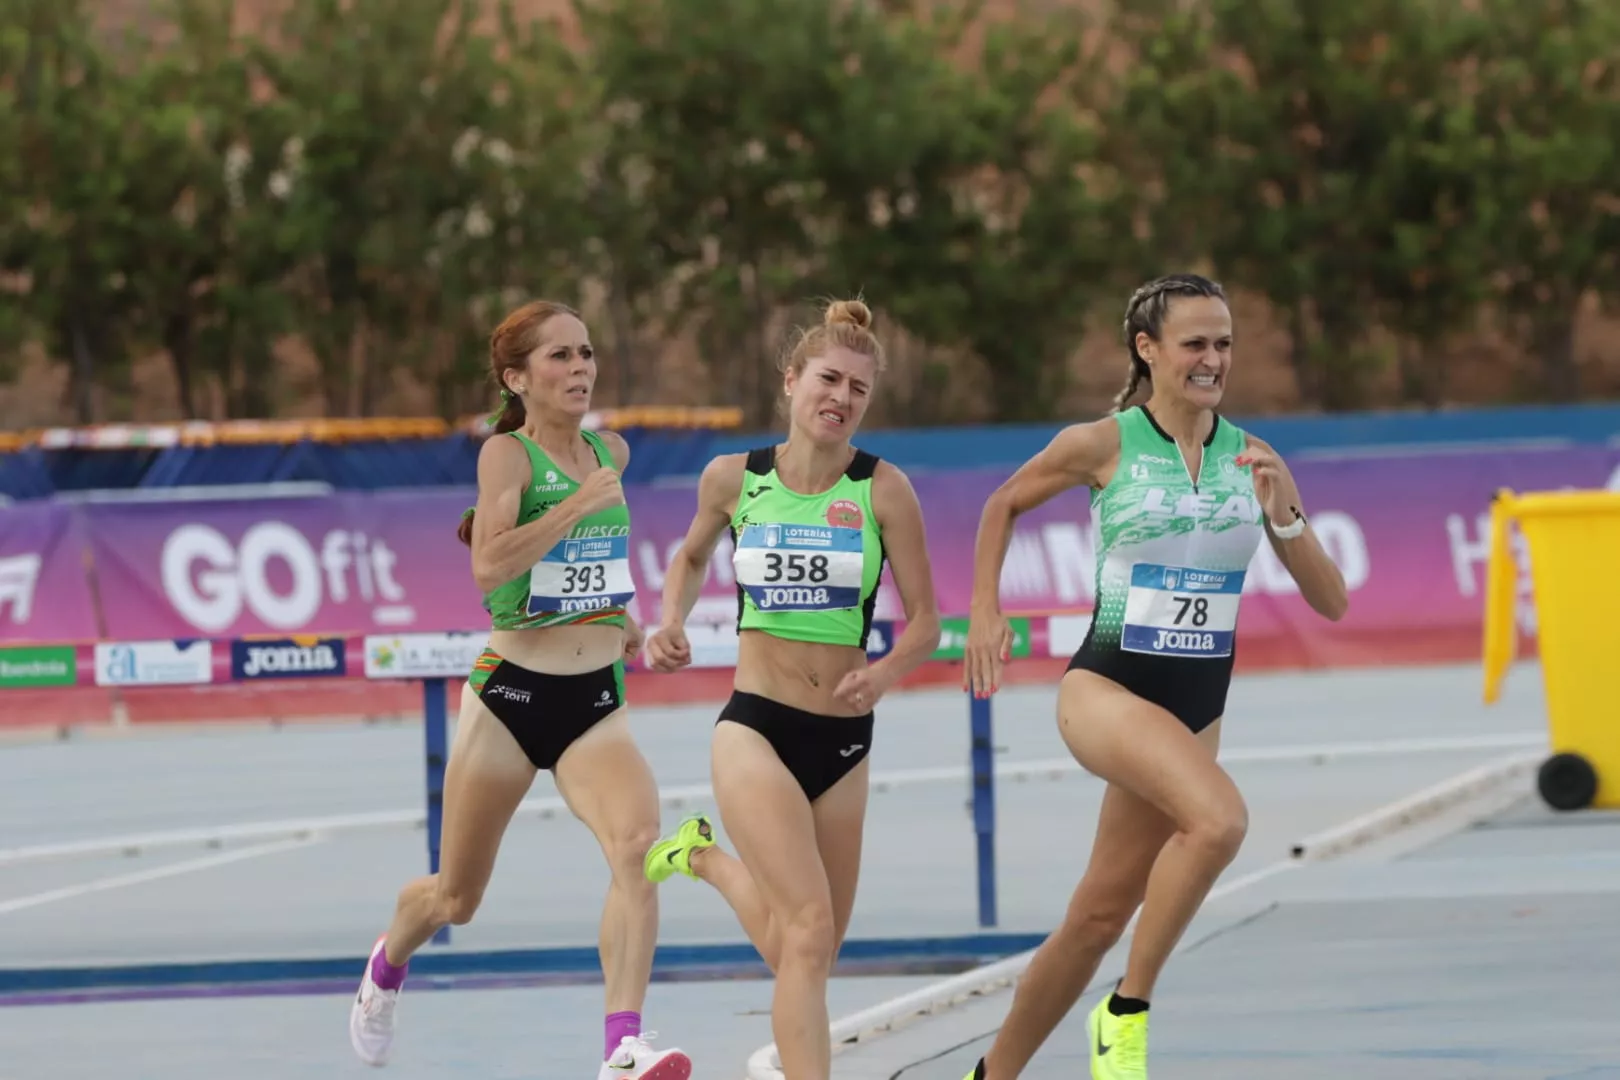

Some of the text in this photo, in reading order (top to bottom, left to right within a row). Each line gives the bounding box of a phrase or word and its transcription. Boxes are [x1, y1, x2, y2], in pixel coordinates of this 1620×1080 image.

[535, 483, 569, 493] VIATOR
[561, 563, 607, 594] 393
[763, 552, 829, 583] 358
[1172, 595, 1209, 628] 78
